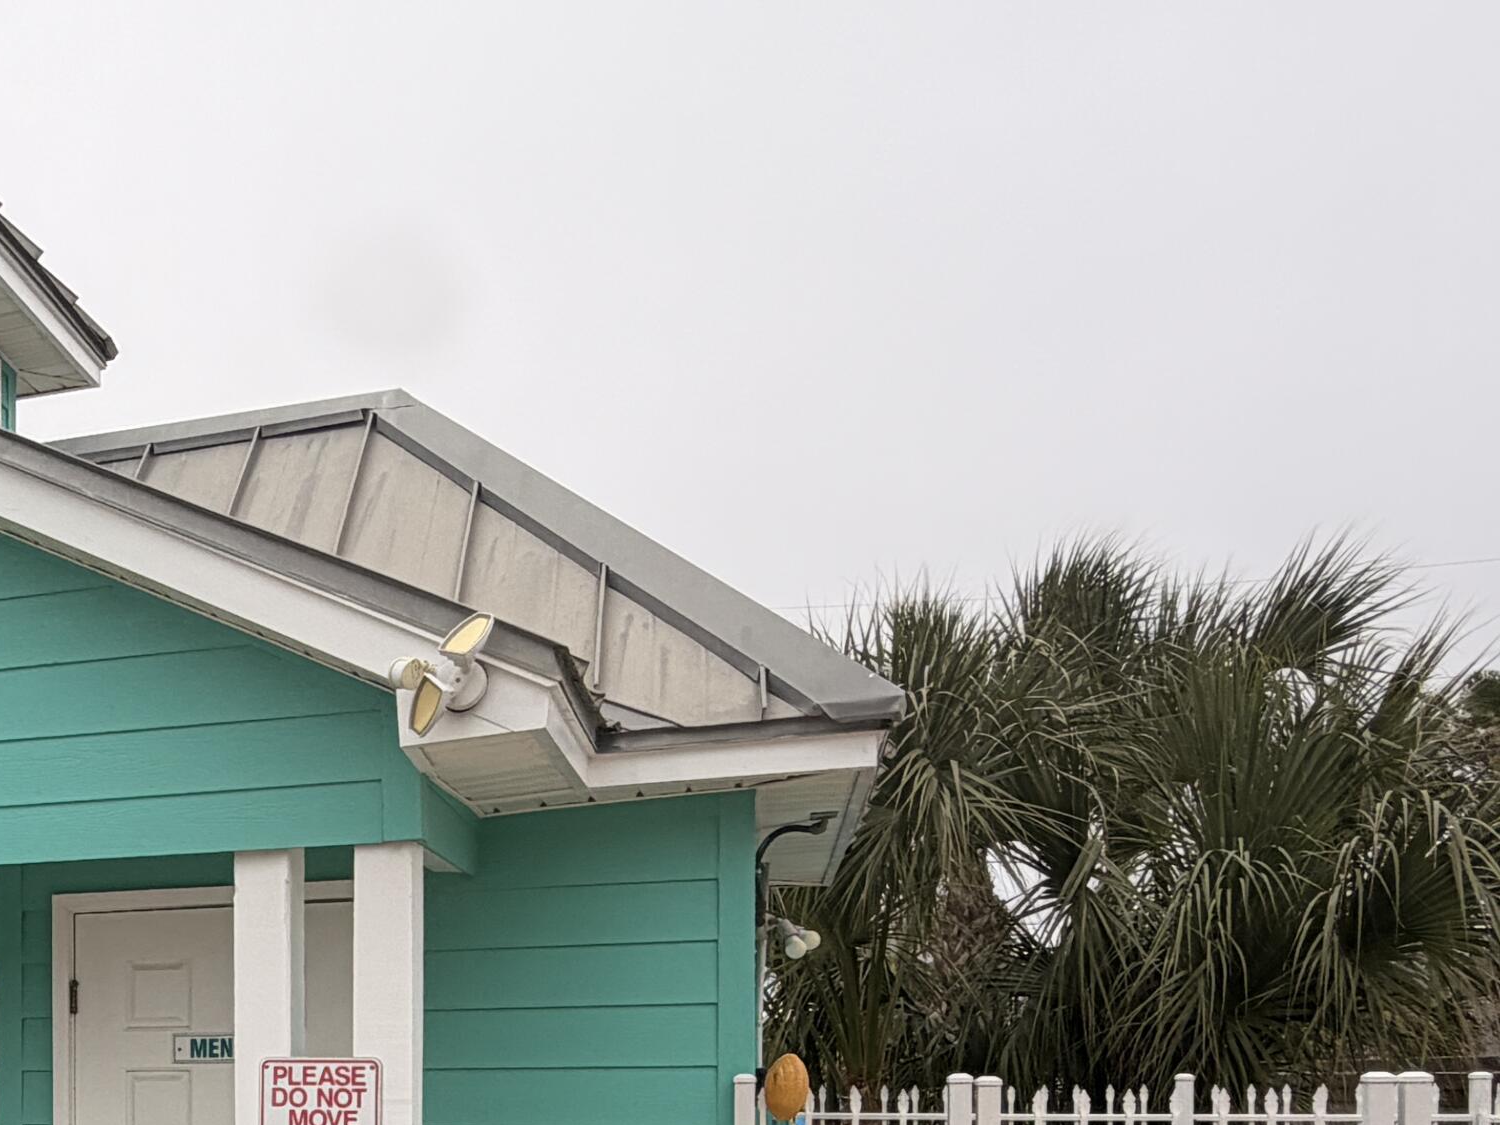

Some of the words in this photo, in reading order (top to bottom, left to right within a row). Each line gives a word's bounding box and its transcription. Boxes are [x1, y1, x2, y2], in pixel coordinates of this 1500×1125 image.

[190, 1038, 233, 1058] MEN
[272, 1066, 366, 1086] PLEASE
[271, 1088, 308, 1108] DO
[316, 1088, 367, 1108] NOT
